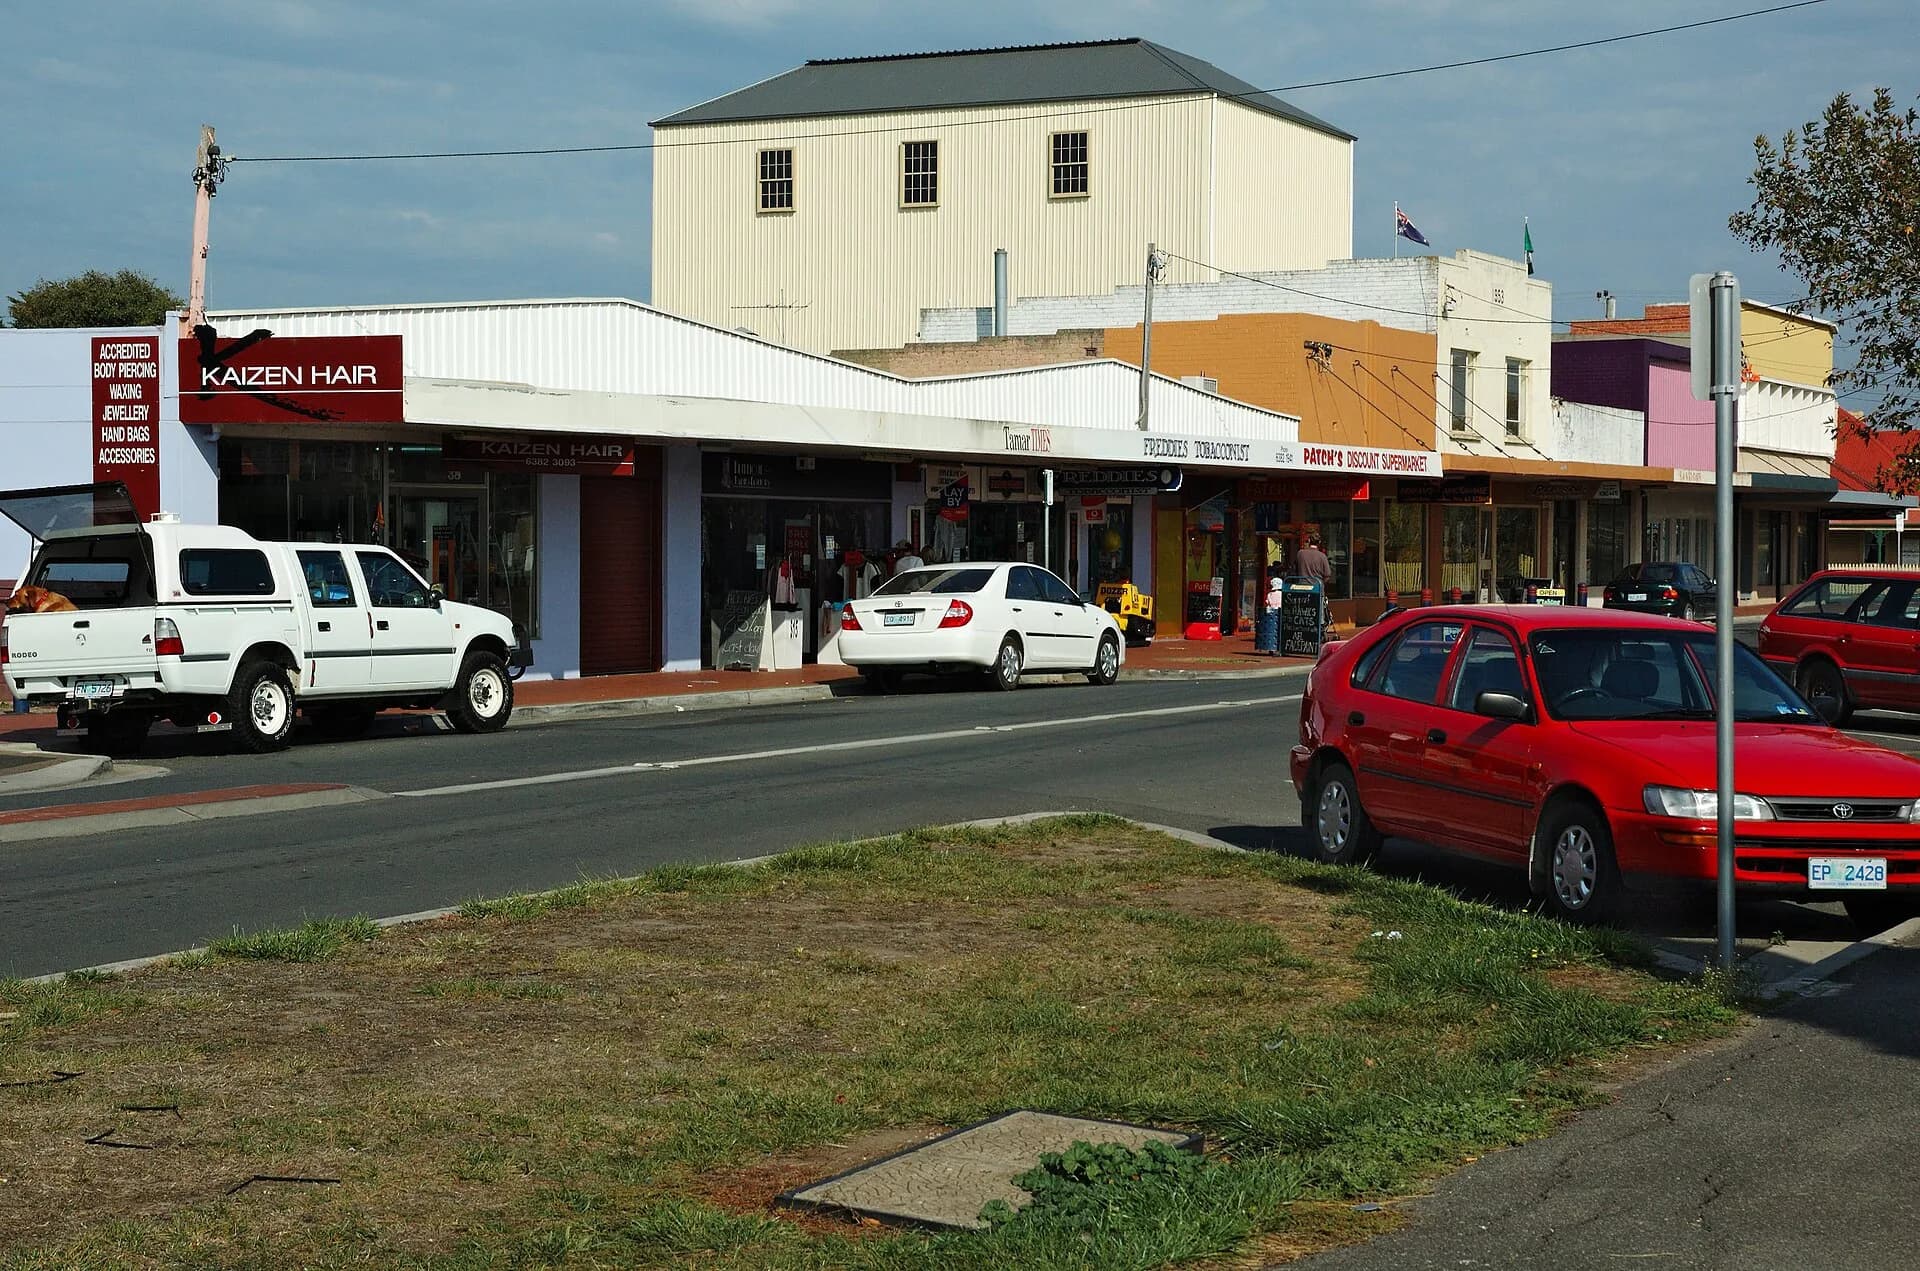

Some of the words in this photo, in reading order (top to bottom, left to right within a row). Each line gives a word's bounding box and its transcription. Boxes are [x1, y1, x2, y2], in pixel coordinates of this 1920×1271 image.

[99, 343, 151, 360] ACCREDITED
[94, 363, 116, 379] BODY
[118, 362, 157, 379] PIERCING
[201, 366, 302, 386] KAIZEN
[310, 365, 377, 385] HAIR
[109, 384, 142, 400] WAXING
[102, 405, 150, 422] JEWELLERY
[101, 426, 125, 443] HAND
[127, 426, 150, 442] BAGS
[99, 447, 155, 464] ACCESSORIES
[480, 441, 561, 456] KAIZEN
[570, 444, 624, 457] HAIR
[1143, 438, 1188, 459] FREDDIES
[1194, 441, 1250, 461] TOBACCONIST
[1303, 447, 1343, 467] PATCH'S
[1346, 450, 1380, 470] DISCOUNT
[1381, 452, 1427, 472] SUPERMARKET
[944, 487, 964, 497] LAY
[947, 497, 961, 506] BY
[1101, 587, 1128, 595] DOZER
[11, 651, 38, 659] RODEO
[92, 683, 112, 694] 5726
[1812, 865, 1831, 880] EP
[1845, 865, 1884, 881] 2428
